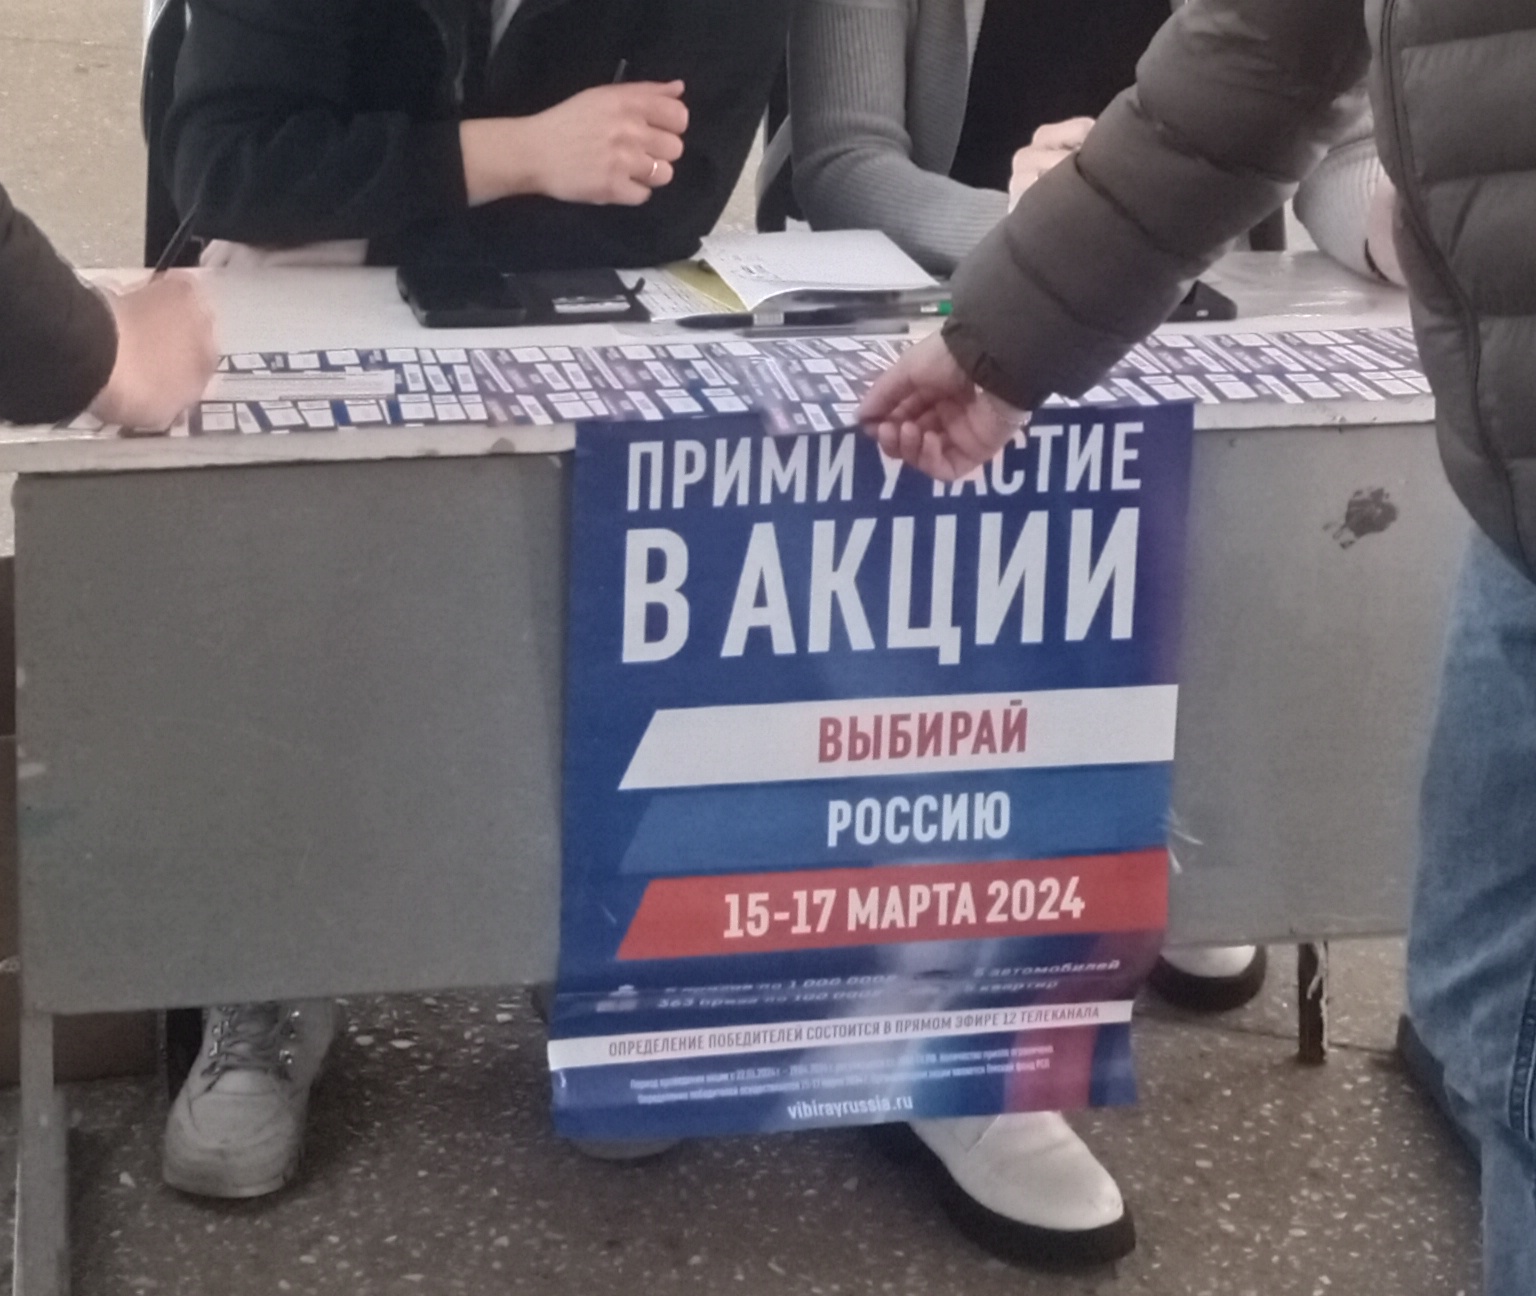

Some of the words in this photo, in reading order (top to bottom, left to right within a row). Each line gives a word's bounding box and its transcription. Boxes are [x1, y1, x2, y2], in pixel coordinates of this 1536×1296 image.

[627, 433, 855, 511] ПРИМИ
[877, 422, 1145, 500] УАСТИЕ
[622, 529, 690, 664] В
[720, 508, 1140, 665] АКЦИИ
[818, 699, 1028, 763] ВЫБИРАЙ
[827, 791, 1011, 847] РОССИЮ
[723, 889, 837, 939] 15-17
[847, 882, 977, 932] МАРТА
[985, 876, 1085, 922] 2024
[989, 959, 1120, 977] автомобилей
[609, 1035, 704, 1056] ОПРЕДЕЛЕНИЕ
[708, 1025, 803, 1049] ПОБЕДИТЕЛЕЙ
[806, 1021, 880, 1041] СОСТОИТСЯ
[883, 1020, 892, 1035] В
[895, 1017, 952, 1033] ПРЯМОМ
[955, 1012, 1000, 1028] ЭФИРЕ
[1003, 1012, 1017, 1025] 12
[1021, 1007, 1100, 1023] ТЕЛЕКАНАЛА
[787, 1095, 913, 1119] vibirayrussia.ru
